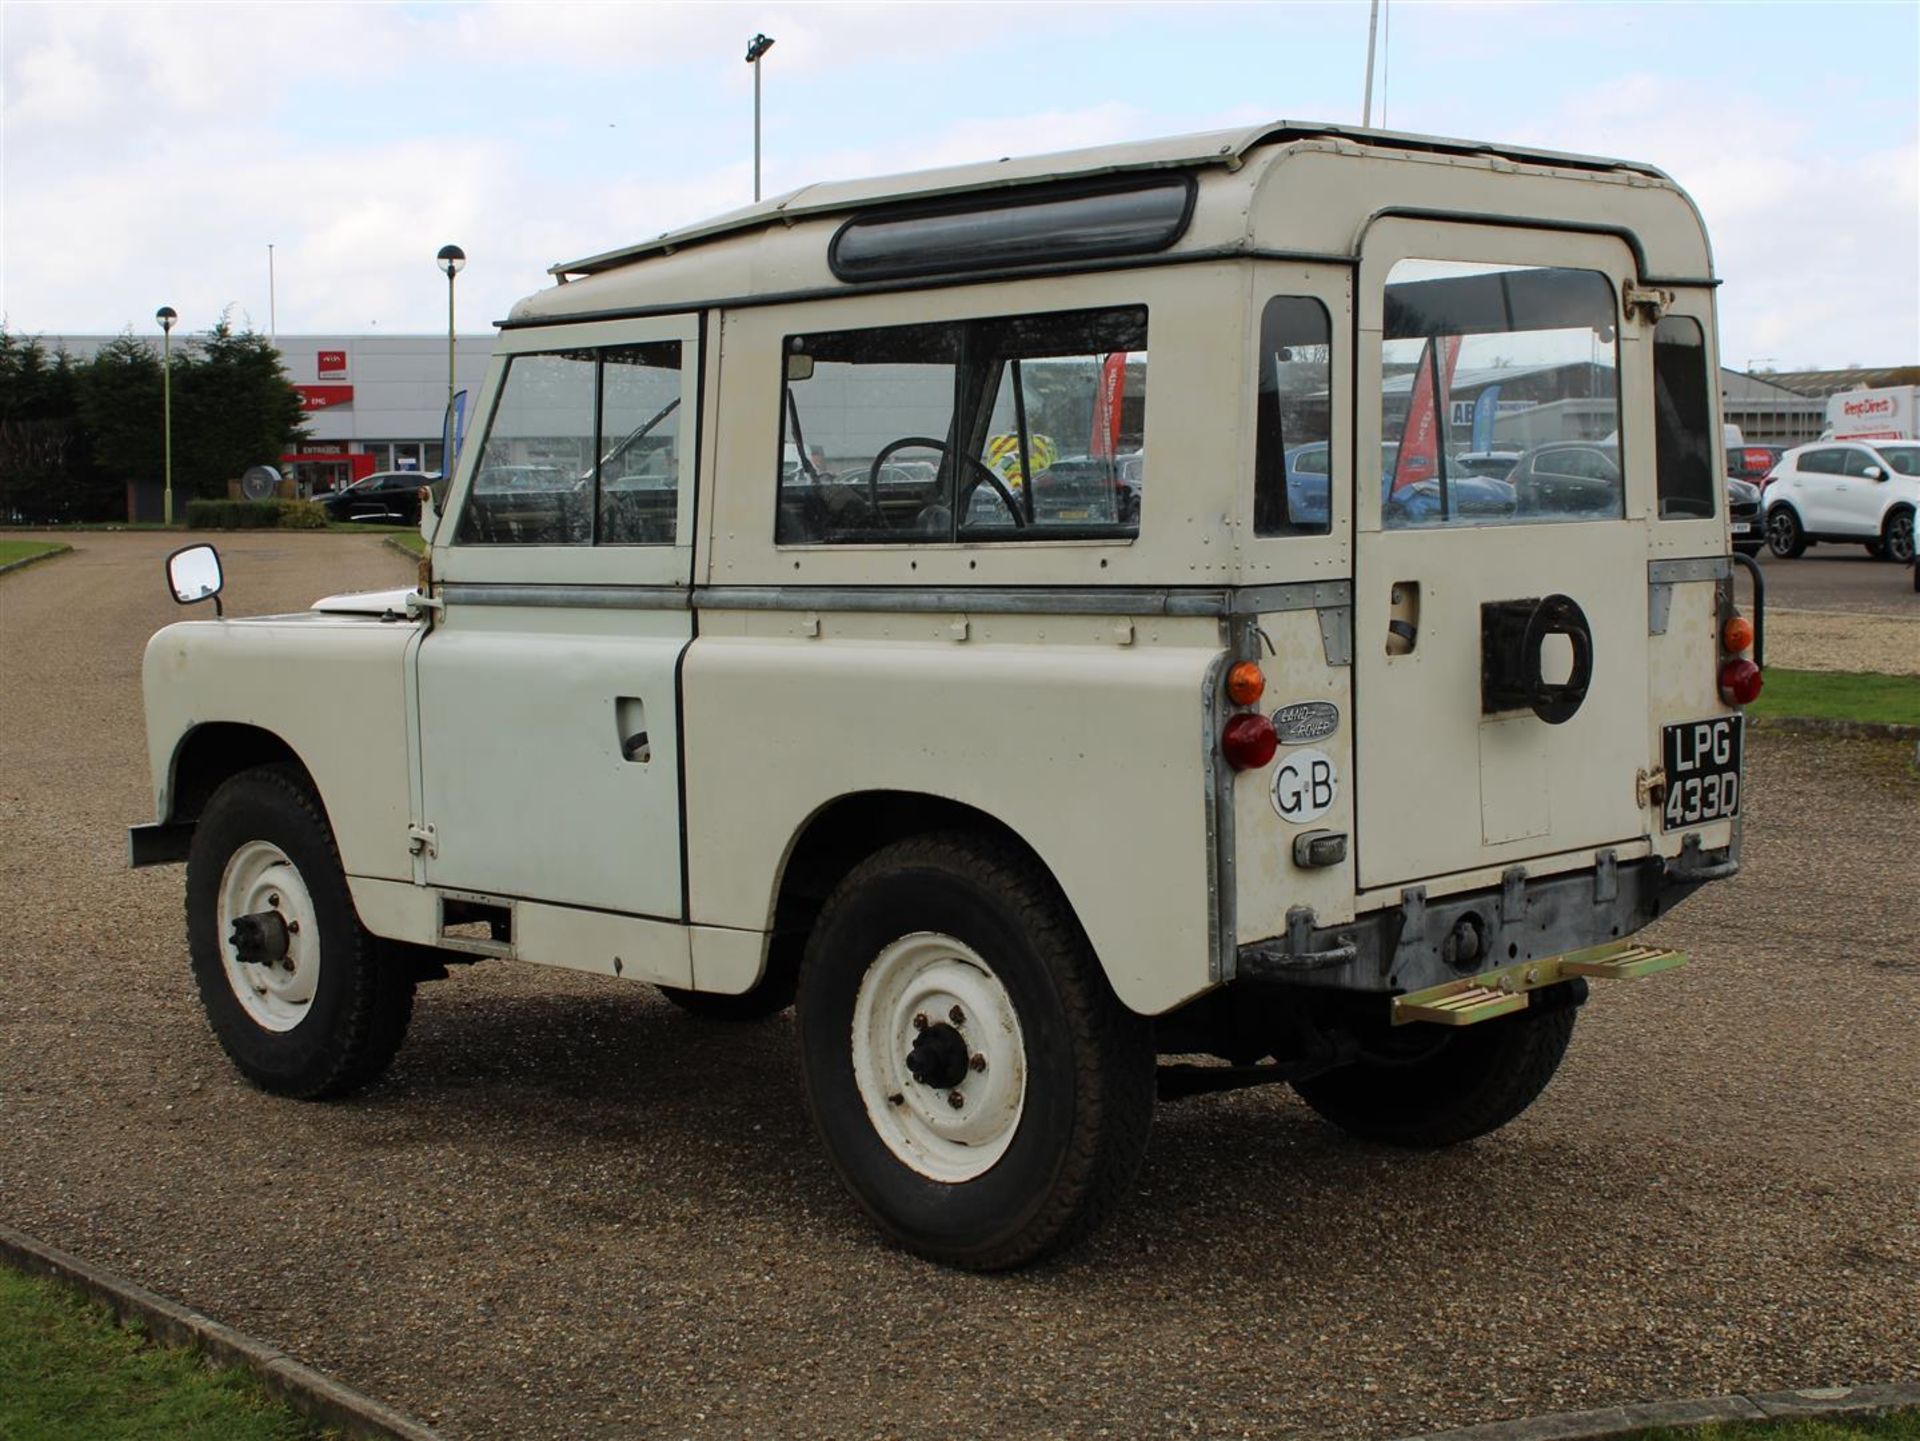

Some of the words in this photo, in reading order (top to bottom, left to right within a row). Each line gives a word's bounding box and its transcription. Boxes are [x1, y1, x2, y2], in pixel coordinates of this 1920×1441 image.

[1281, 706, 1312, 723] LAND
[1297, 721, 1329, 737] ROVER
[1676, 721, 1730, 772] LPG
[1277, 760, 1332, 814] GB
[1666, 771, 1738, 824] 433D
